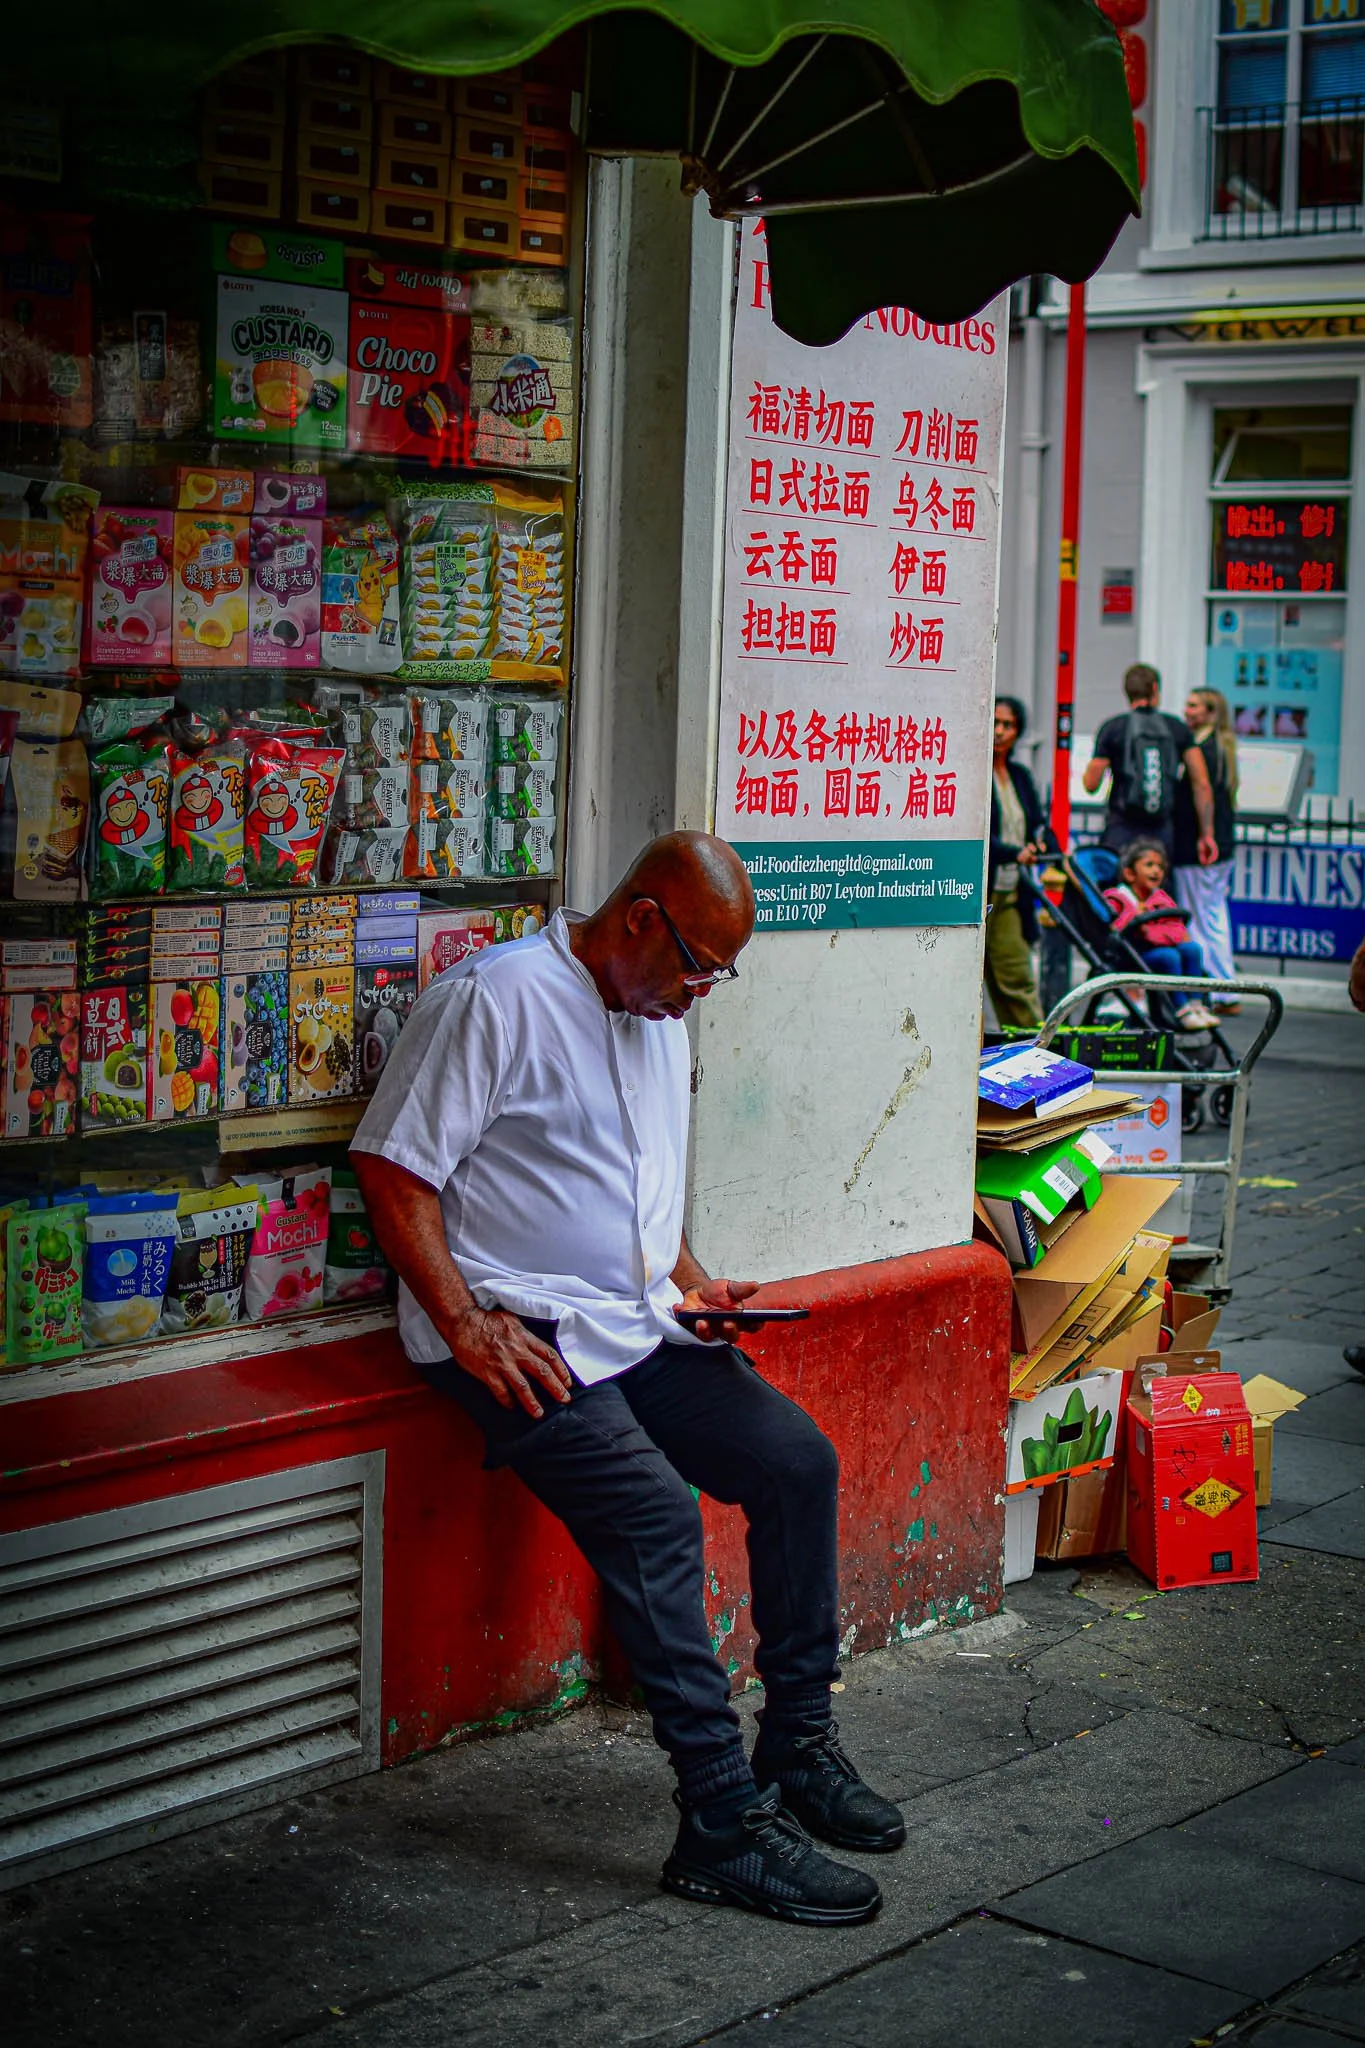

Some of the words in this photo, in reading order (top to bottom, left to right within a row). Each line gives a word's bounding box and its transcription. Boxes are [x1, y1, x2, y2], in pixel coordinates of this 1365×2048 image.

[421, 274, 463, 295] Choco
[260, 304, 285, 315] KOREA
[233, 317, 333, 362] CUSTARD
[356, 336, 437, 374] Choco
[291, 351, 312, 368] 1989
[356, 372, 403, 407] Pie
[493, 370, 555, 413] 小米通
[746, 380, 875, 449] 福清切面
[895, 407, 978, 464] 刀削面
[750, 457, 870, 519] 日式拉面
[893, 471, 976, 533] 乌冬面
[744, 530, 837, 586] 云吞面
[888, 540, 946, 596] 伊面
[741, 598, 837, 656] 担担面
[888, 611, 944, 664] 炒面
[382, 718, 391, 758] SEAWEED
[460, 711, 468, 751] SEAWEED
[535, 712, 543, 751] SEAWEED
[737, 708, 947, 766] 以及各种规格的
[146, 776, 168, 800] Ta
[222, 766, 245, 791] Ta
[300, 777, 330, 801] Tao
[384, 777, 393, 818] SEAWEED
[459, 770, 467, 808] SEAWEED
[535, 770, 543, 808] SEAWEED
[304, 799, 324, 817] Ka
[374, 837, 388, 876] SEAWEED
[457, 827, 465, 866] SEAWEED
[534, 825, 543, 864] SEAWEED
[810, 883, 832, 900] B07
[835, 882, 875, 903] Leyton
[877, 880, 935, 898] Industrial
[936, 879, 974, 899] Village
[776, 904, 799, 922] E10
[801, 903, 827, 924] 7QP
[1233, 923, 1336, 957] HERBS
[106, 997, 126, 1048] 日式
[293, 997, 349, 1023] 和風もち
[183, 1034, 193, 1065] Fruity
[253, 1026, 264, 1056] Fruity
[36, 1053, 44, 1077] Mochi
[42, 1049, 52, 1081] Fruity
[267, 1221, 318, 1250] Mochi
[276, 1211, 308, 1228] Custard
[1022, 1208, 1038, 1249] RAJAH
[121, 1279, 136, 1287] Milk
[142, 1242, 152, 1295] 鮮奶大福
[153, 1241, 167, 1294] みるく
[198, 1280, 210, 1288] Milk
[116, 1287, 136, 1296] Mochi
[203, 1284, 219, 1292] Mochi
[1195, 1488, 1232, 1508] 酸梅汤
